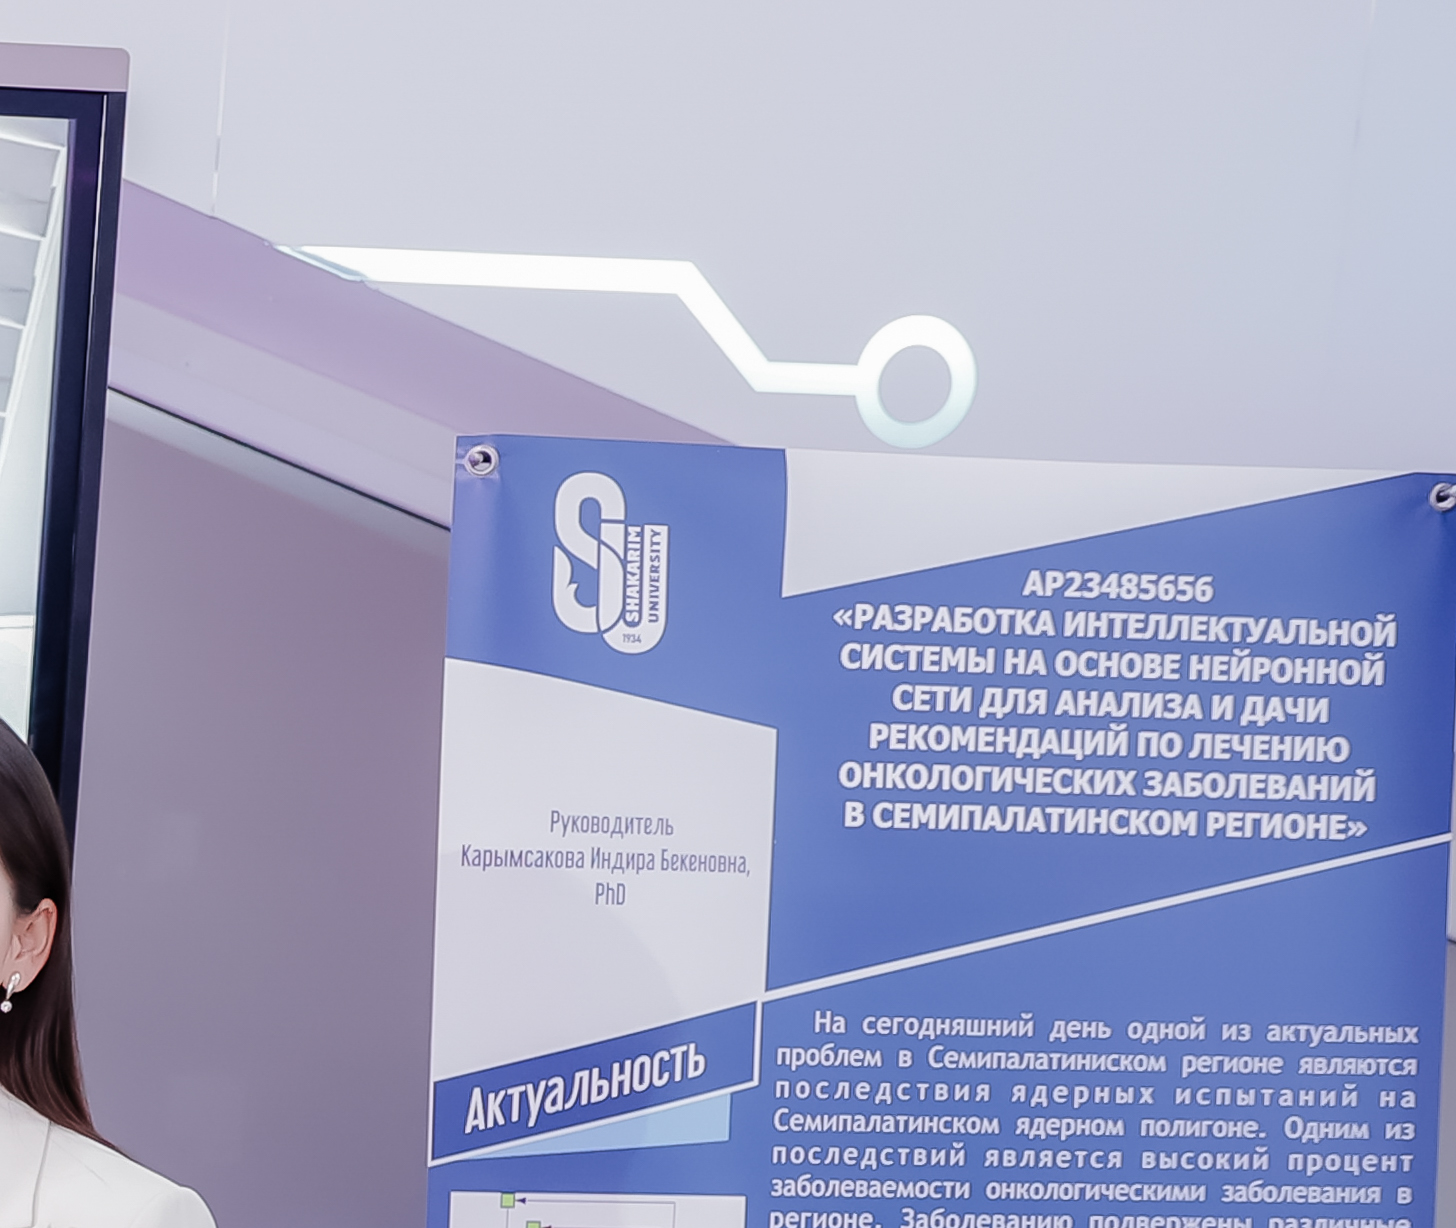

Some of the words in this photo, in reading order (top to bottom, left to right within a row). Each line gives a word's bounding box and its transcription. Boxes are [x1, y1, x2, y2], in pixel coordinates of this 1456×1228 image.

[625, 525, 642, 623] SHAKARIM
[648, 528, 662, 623] UNIVERSITY
[622, 633, 642, 644] 1934
[834, 604, 1055, 636] «РАЗРАБОТКА
[1064, 611, 1396, 646] ИНТЕЛЛЕКТУАЛЬНОЙ
[841, 643, 995, 673] СИСТЕМЫ
[1005, 649, 1046, 675] НА
[1055, 650, 1181, 679] ОСНОВЕ
[1189, 649, 1384, 685] НЕЙРОННОЙ
[893, 684, 972, 712] СЕТИ
[979, 688, 1047, 718] ДЛЯ
[1055, 690, 1202, 719] АНАЛИЗА
[1212, 695, 1234, 720] И
[1240, 696, 1328, 726] ДАЧИ
[870, 723, 1128, 760] РЕКОМЕНДАЦИЙ
[1138, 732, 1182, 758] ПО
[1189, 733, 1349, 762] ЛЕЧЕНИЮ
[839, 762, 1136, 795] ОНКОЛОГИЧЕСКИХ
[1143, 769, 1375, 801] ЗАБОЛЕВАНИЙ
[551, 810, 674, 839] Руководитель
[845, 802, 864, 827] В
[873, 802, 1197, 836] СЕМИПАЛАТИНСКОМ
[1207, 812, 1367, 839] РЕГИОНЕ»
[461, 845, 584, 871] Карымсакова
[591, 847, 655, 874] Индира
[661, 849, 751, 877] Бекеновна,
[595, 882, 625, 905] PhD
[815, 1011, 845, 1033] На
[863, 1013, 1033, 1039] сегодняшний
[1049, 1021, 1111, 1042] день
[1128, 1017, 1205, 1043] одной
[1222, 1024, 1250, 1041] из
[1267, 1025, 1418, 1047] актуальных
[777, 1043, 881, 1071] проблем
[899, 1050, 912, 1067] в
[929, 1046, 1166, 1071] Семипалатиниском
[1182, 1056, 1283, 1077] регионе
[1299, 1057, 1417, 1075] являются
[464, 1043, 705, 1134] Актуальность
